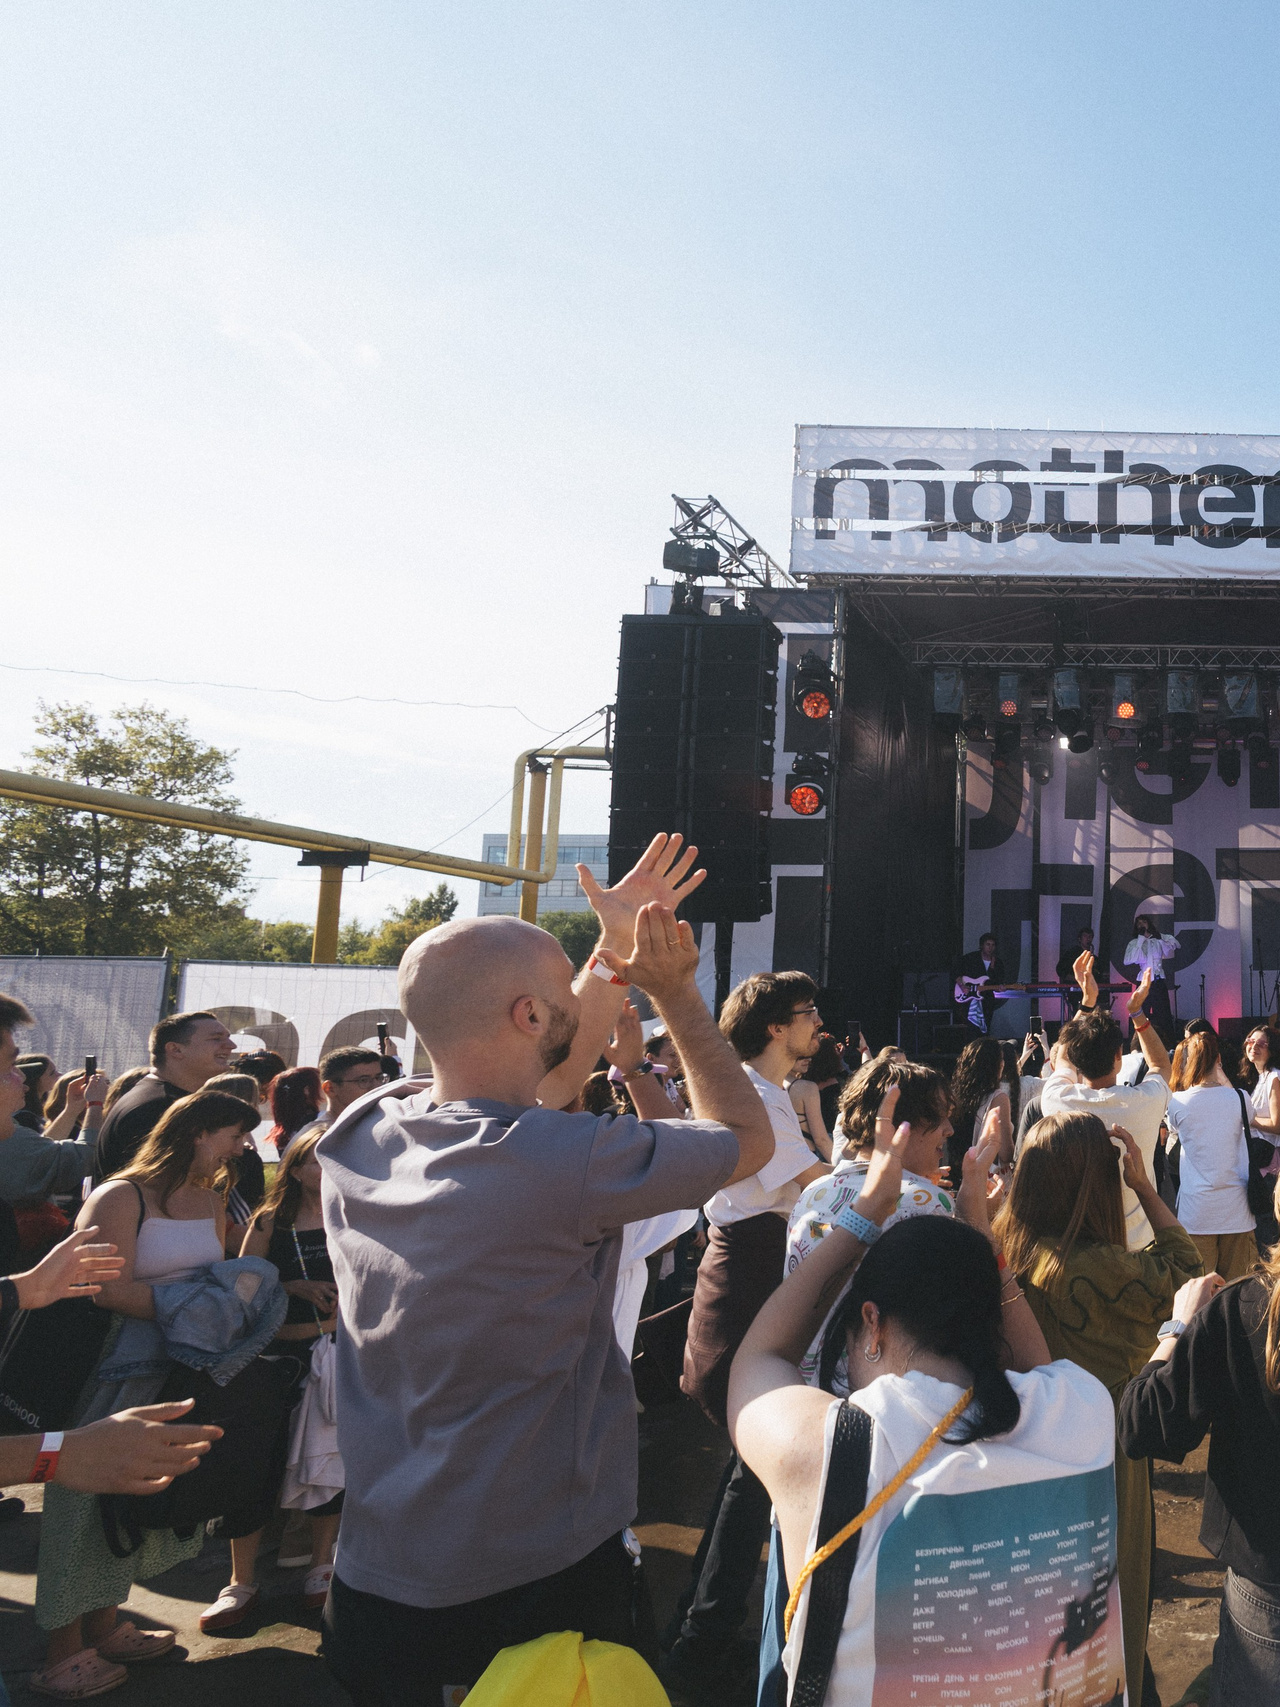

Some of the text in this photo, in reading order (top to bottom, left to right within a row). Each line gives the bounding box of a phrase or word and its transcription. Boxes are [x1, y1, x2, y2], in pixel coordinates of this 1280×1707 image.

[4, 1395, 41, 1429] SCHOOL
[972, 1539, 1004, 1553] ДИСКОМ
[1028, 1529, 1060, 1541] ОБЛАКАХ
[1011, 1549, 1030, 1559] ВОЛН
[1056, 1538, 1078, 1549] УТОНУТ
[914, 1576, 949, 1586] ВЫГИБАЯ
[1010, 1563, 1030, 1573] НЕОН
[1048, 1552, 1078, 1565] ОКРАСИЛ
[936, 1586, 978, 1599] ХОЛОДНЫЙ
[990, 1582, 1008, 1591] СВЕТ
[1024, 1569, 1062, 1584] ХОЛОДНОЙ
[913, 1606, 935, 1617] ДАЖЕ
[958, 1603, 969, 1611] НЕ
[1034, 1586, 1054, 1598] ДАЖЕ
[1071, 1579, 1079, 1588] НЕ
[913, 1621, 935, 1630] ВЕТЕР
[1009, 1607, 1025, 1617] НАС
[1057, 1595, 1075, 1606] УКРАЛ
[913, 1634, 945, 1643] ХОЧЕШЬ
[985, 1626, 1009, 1638] ПРЫГНУ
[996, 1636, 1029, 1651] ВЫСОКИХ
[1048, 1626, 1065, 1637] СКАЛ
[912, 1673, 939, 1683] ТРЕТИЙ
[944, 1675, 964, 1684] ДЕНЬ
[969, 1674, 979, 1682] НЕ
[984, 1668, 1023, 1682] СМОТРИМ
[941, 1690, 970, 1698] ПУТАЕМ
[995, 1686, 1012, 1696] СОН
